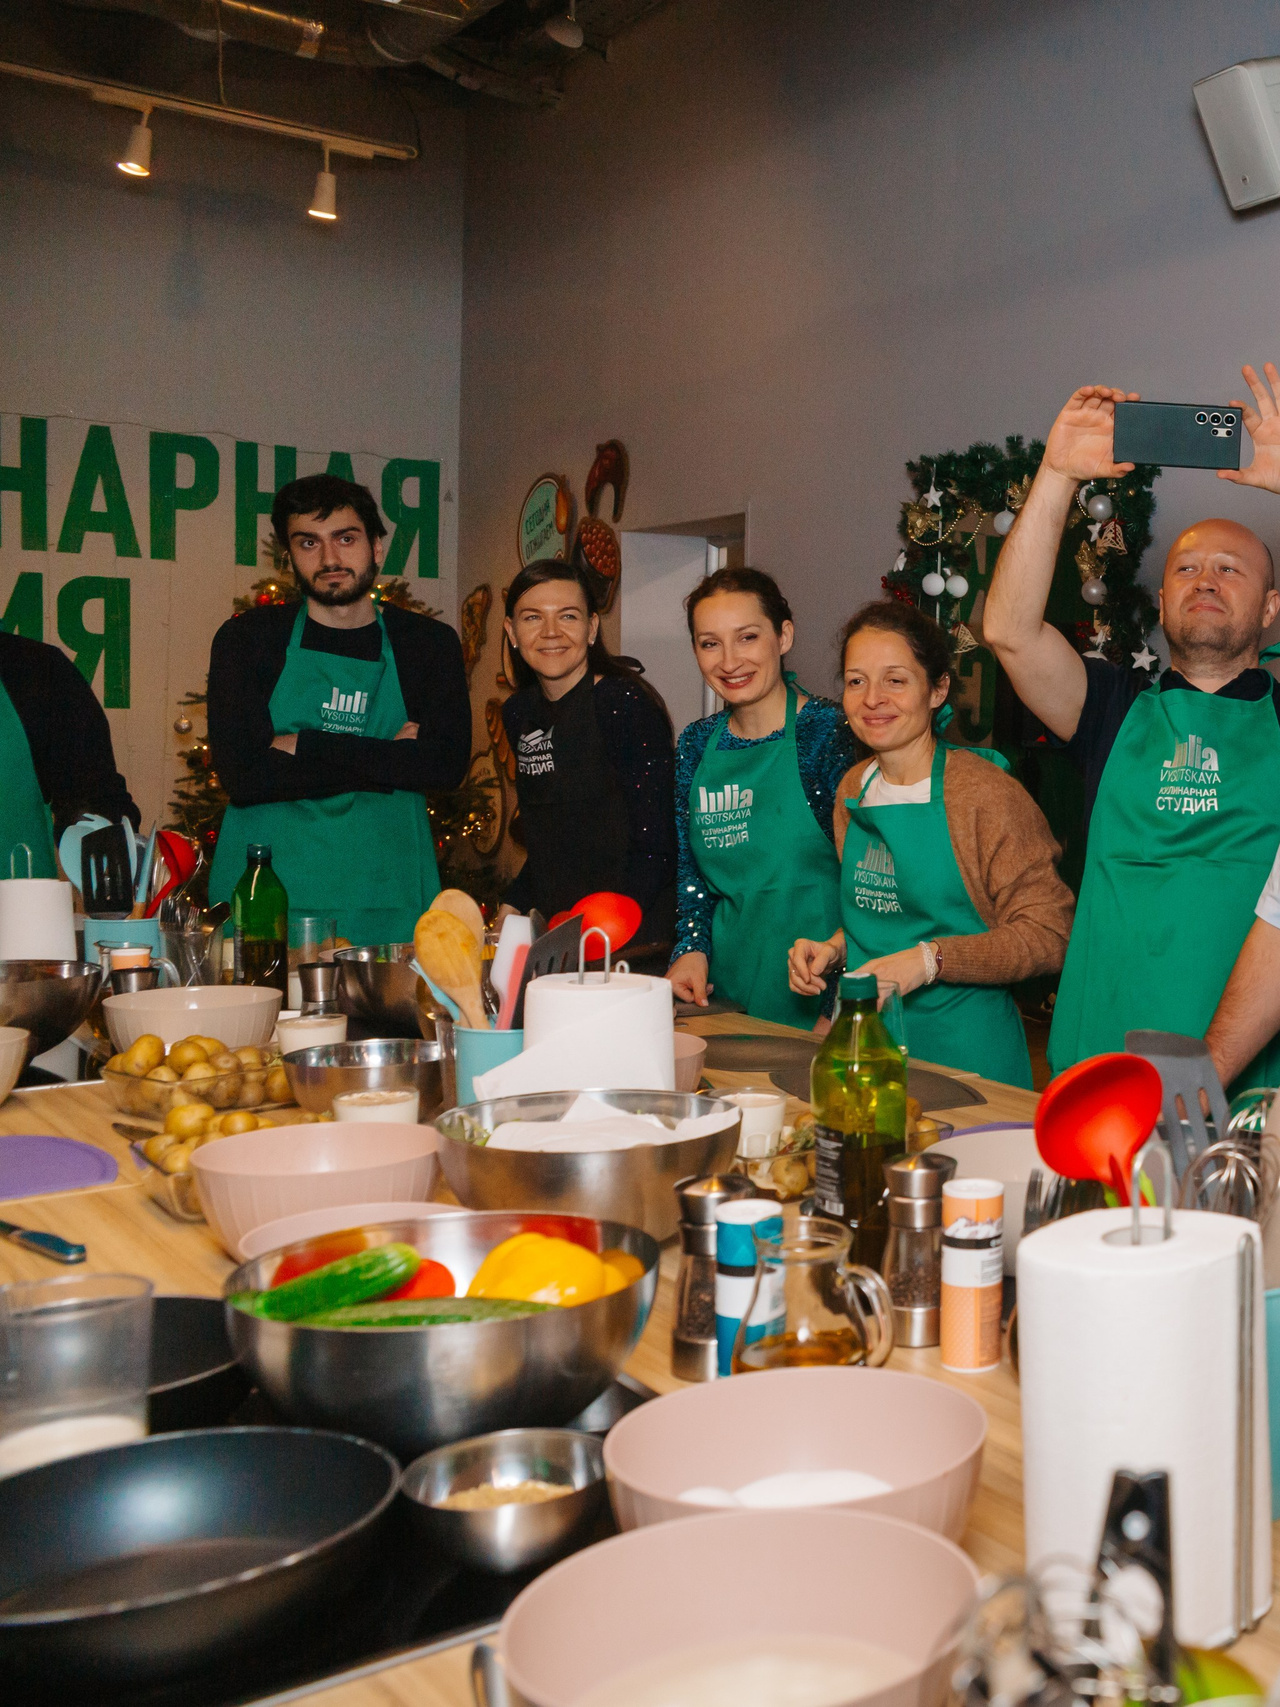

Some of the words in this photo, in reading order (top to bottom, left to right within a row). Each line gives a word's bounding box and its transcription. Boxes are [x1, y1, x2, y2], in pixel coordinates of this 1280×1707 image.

[0, 416, 440, 579] НАРНЯ
[1156, 796, 1218, 815] СТУДИЯ
[704, 830, 750, 848] СТУДИЯ
[855, 895, 903, 914] СТУДИЯ
